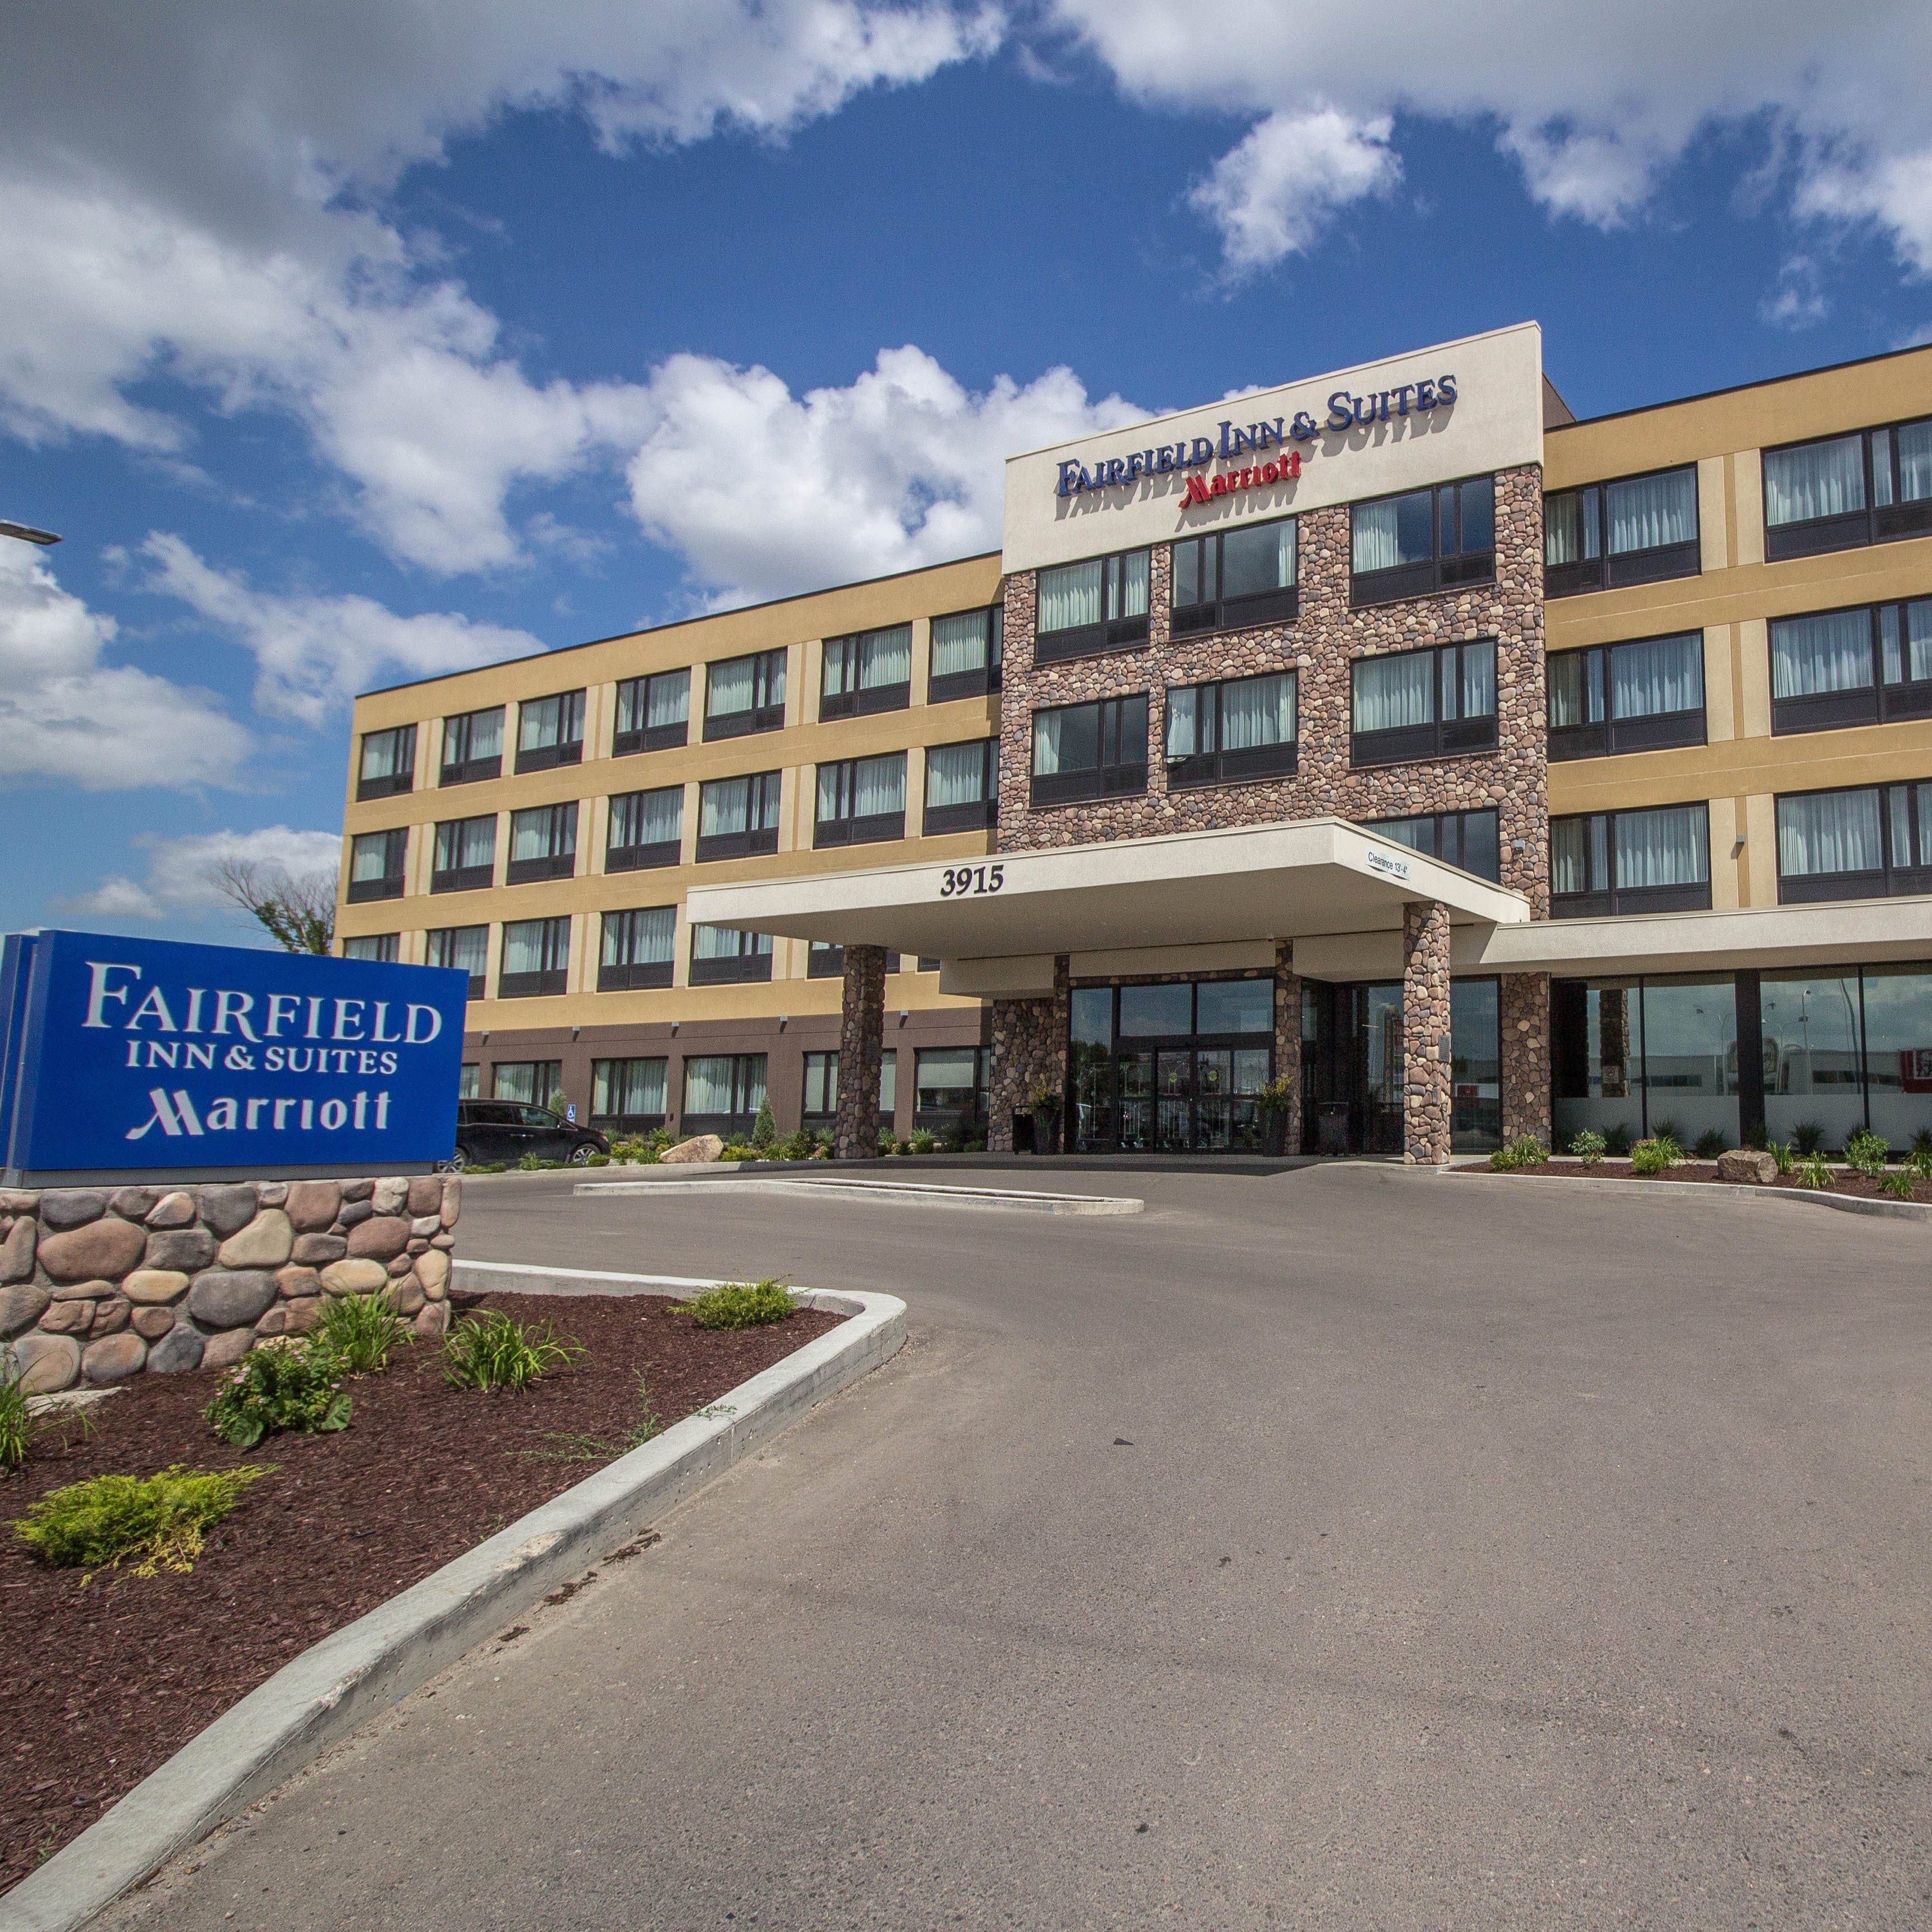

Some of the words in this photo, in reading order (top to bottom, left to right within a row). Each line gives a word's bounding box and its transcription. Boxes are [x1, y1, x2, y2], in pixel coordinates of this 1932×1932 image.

[1056, 437, 1214, 498] FAIRFIELD
[1218, 417, 1285, 460] INN
[1290, 411, 1320, 441] &
[1327, 375, 1458, 432] SUITES
[1178, 451, 1301, 509] Marriott
[940, 864, 1004, 897] 3915
[1368, 851, 1393, 870] Clearance
[82, 960, 443, 1044] FAIRFIELD
[126, 1040, 217, 1069] INN
[224, 1045, 256, 1070] &
[264, 1046, 398, 1074] SUITES
[125, 1088, 391, 1139] Marriott
